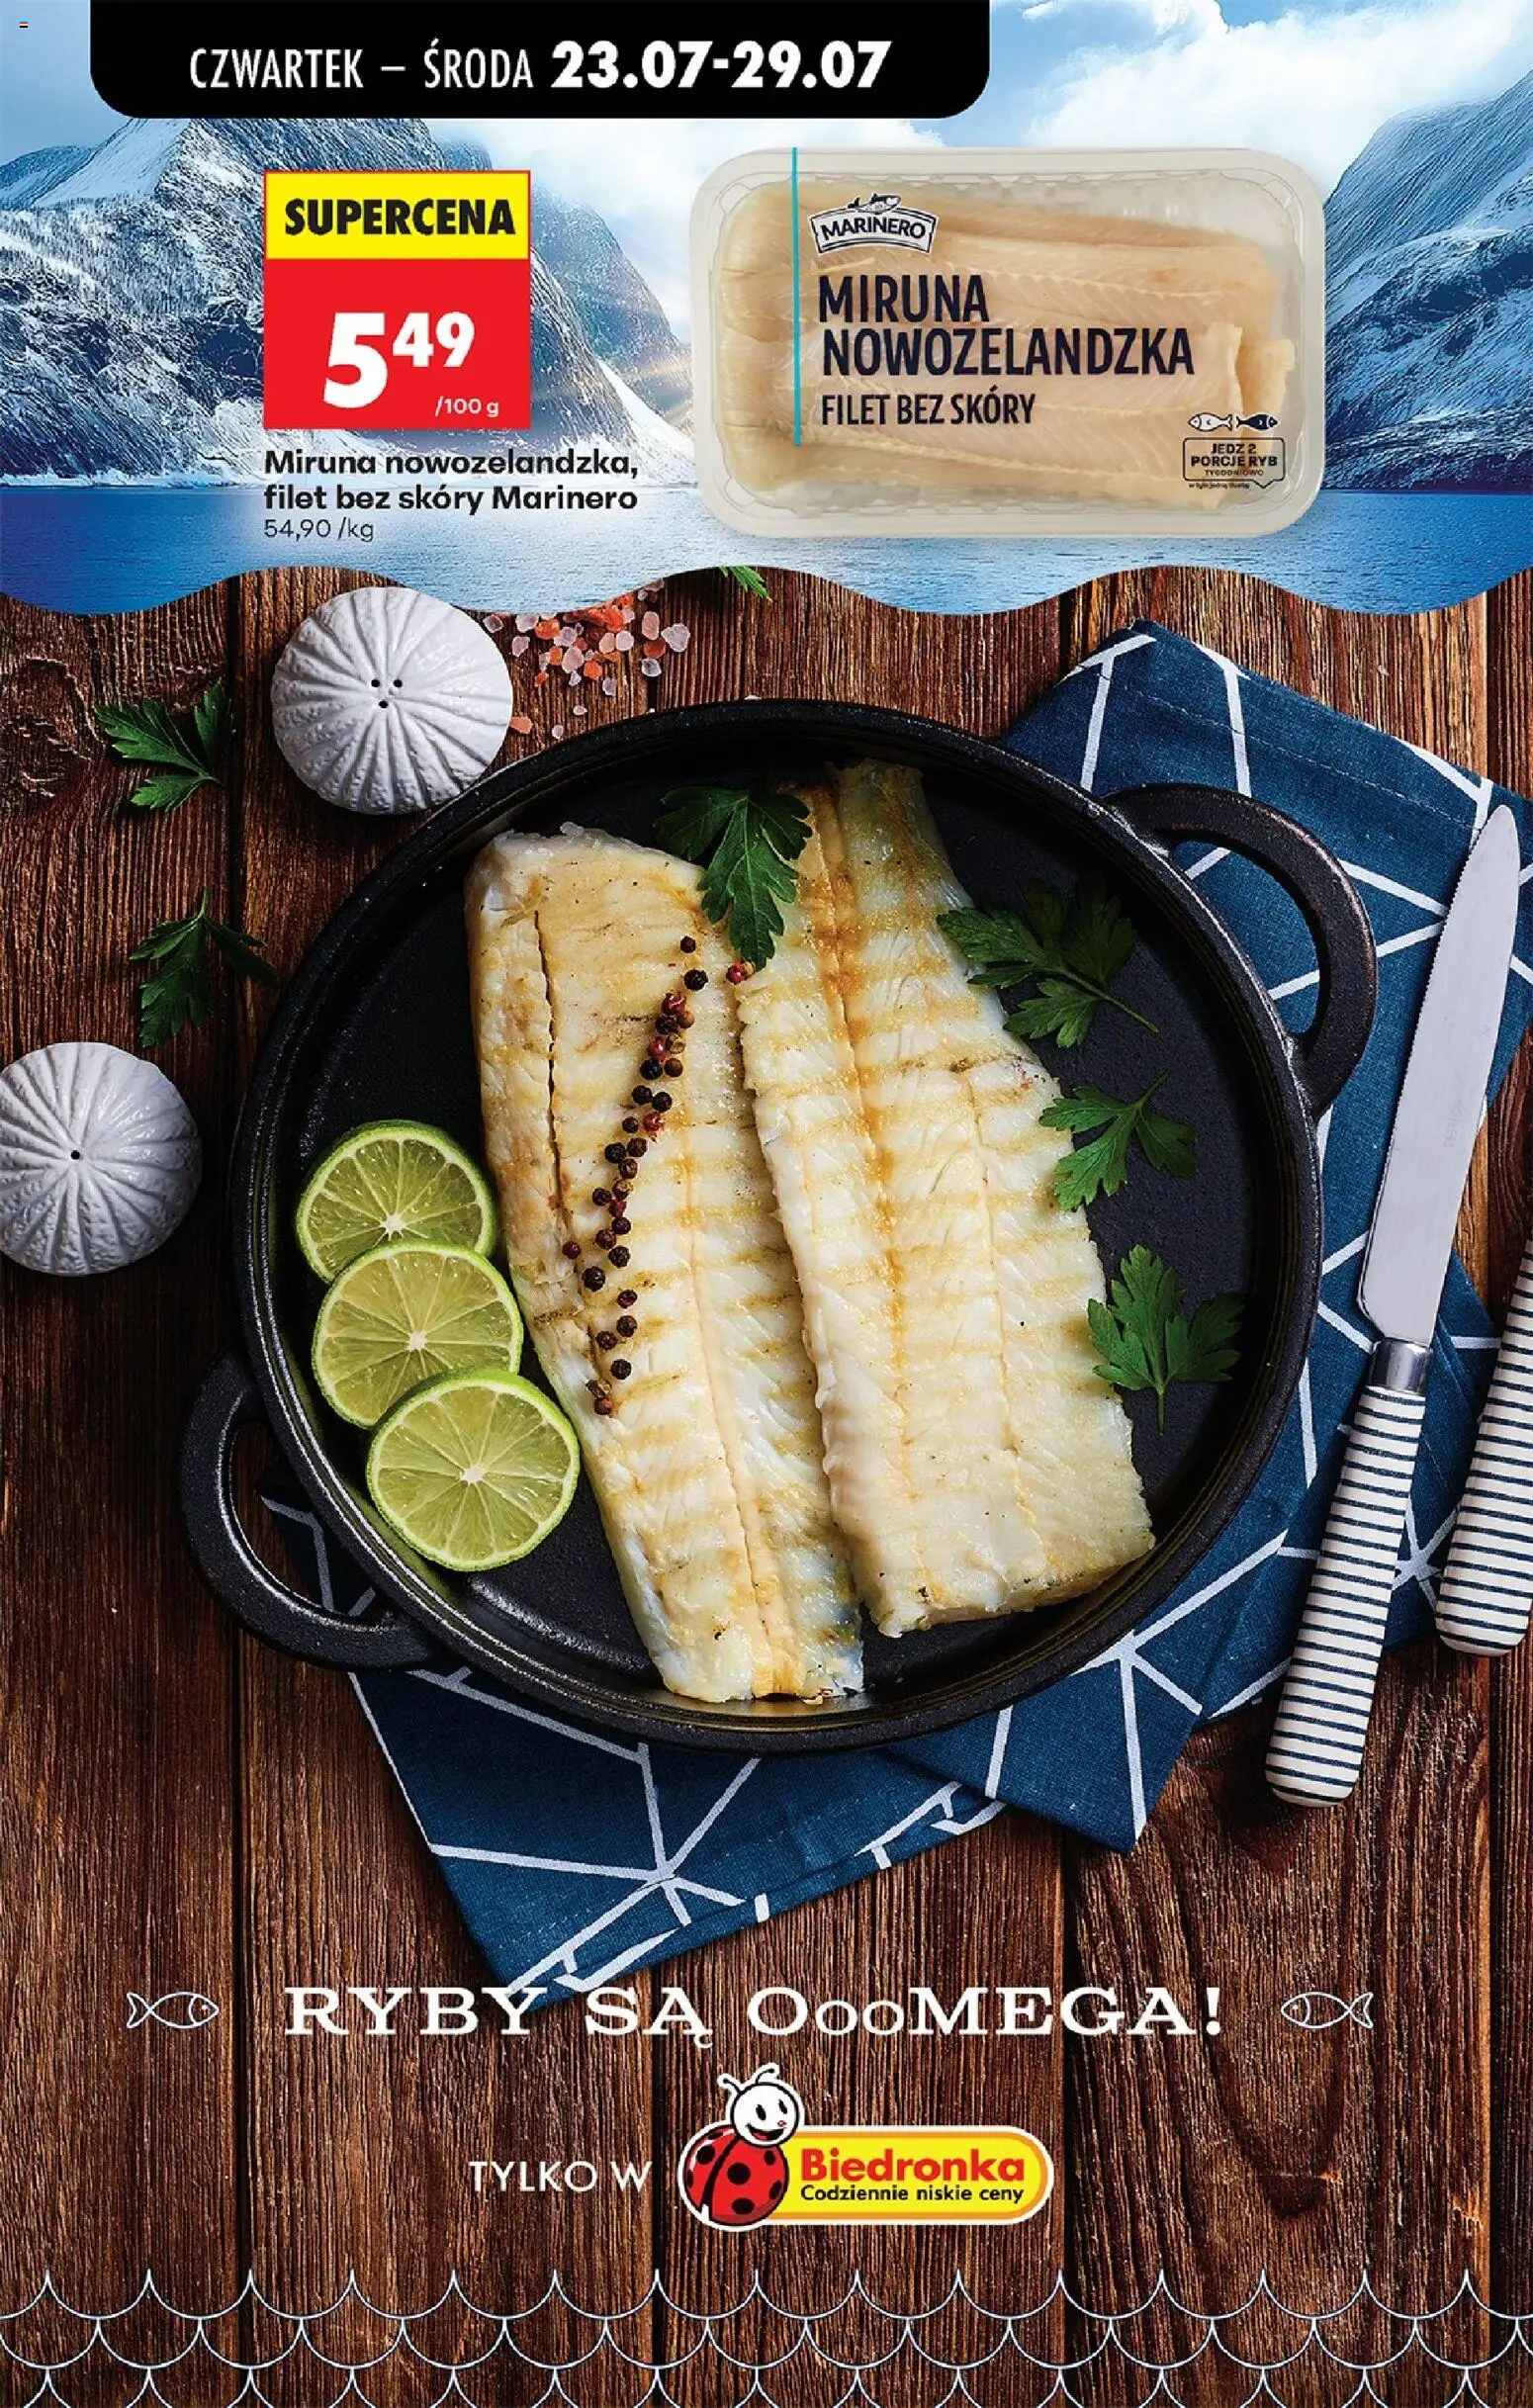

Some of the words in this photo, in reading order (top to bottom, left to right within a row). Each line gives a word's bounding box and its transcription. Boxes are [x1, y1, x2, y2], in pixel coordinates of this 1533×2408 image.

[190, 47, 364, 89] CZWARTEK
[423, 38, 534, 89] ŚRODA
[550, 40, 892, 89] 23.07-29.07
[284, 197, 516, 236] SUPERCENA
[820, 216, 927, 240] MARINERO
[818, 274, 990, 323] MIRUNA
[823, 327, 1196, 376] NOWOZELANDZKA
[434, 396, 482, 417] /100
[486, 401, 499, 418] g
[821, 395, 891, 425] FILET
[896, 394, 946, 425] BEZ
[950, 385, 1037, 425] SKÓRY
[264, 448, 377, 475] Miruna
[385, 448, 638, 479] nowozelandzka,
[1191, 456, 1245, 467] PORCJE
[1248, 456, 1278, 467] RYB
[1211, 443, 1245, 454] JEDZ
[1248, 443, 1257, 454] 2
[264, 485, 327, 509] filet
[337, 485, 391, 509] bez
[399, 484, 483, 516] skóry
[494, 485, 638, 509] Marinero
[263, 519, 331, 541] 54,90
[337, 516, 374, 542] /kg
[285, 1987, 547, 2035] RYBY
[585, 1987, 713, 2049] SĄ
[469, 2161, 597, 2192] TYLKO
[610, 2161, 652, 2192] W
[801, 2148, 1025, 2182] Biedronka
[800, 2185, 909, 2201] Codziennie
[917, 2185, 972, 2200] niskie
[979, 2187, 1024, 2204] ceny
